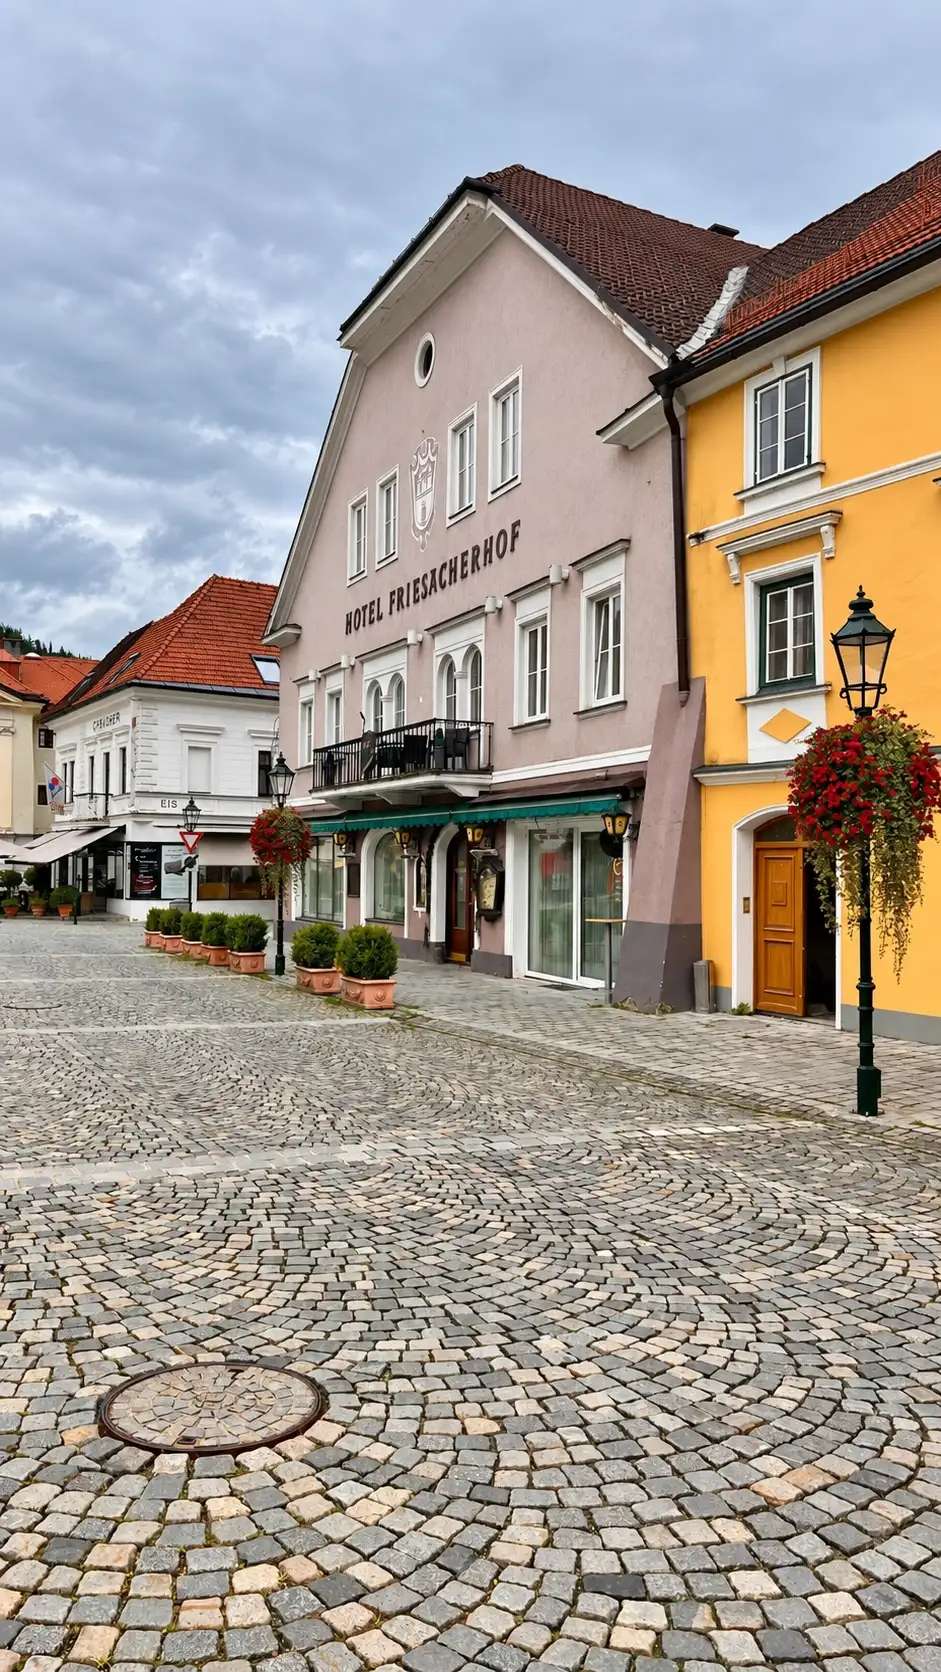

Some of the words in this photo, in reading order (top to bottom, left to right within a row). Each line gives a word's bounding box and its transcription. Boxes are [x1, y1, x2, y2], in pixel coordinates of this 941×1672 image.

[345, 597, 383, 636] HOTEL
[388, 519, 521, 616] FRIESACHERHOF
[160, 799, 178, 809] EIS
